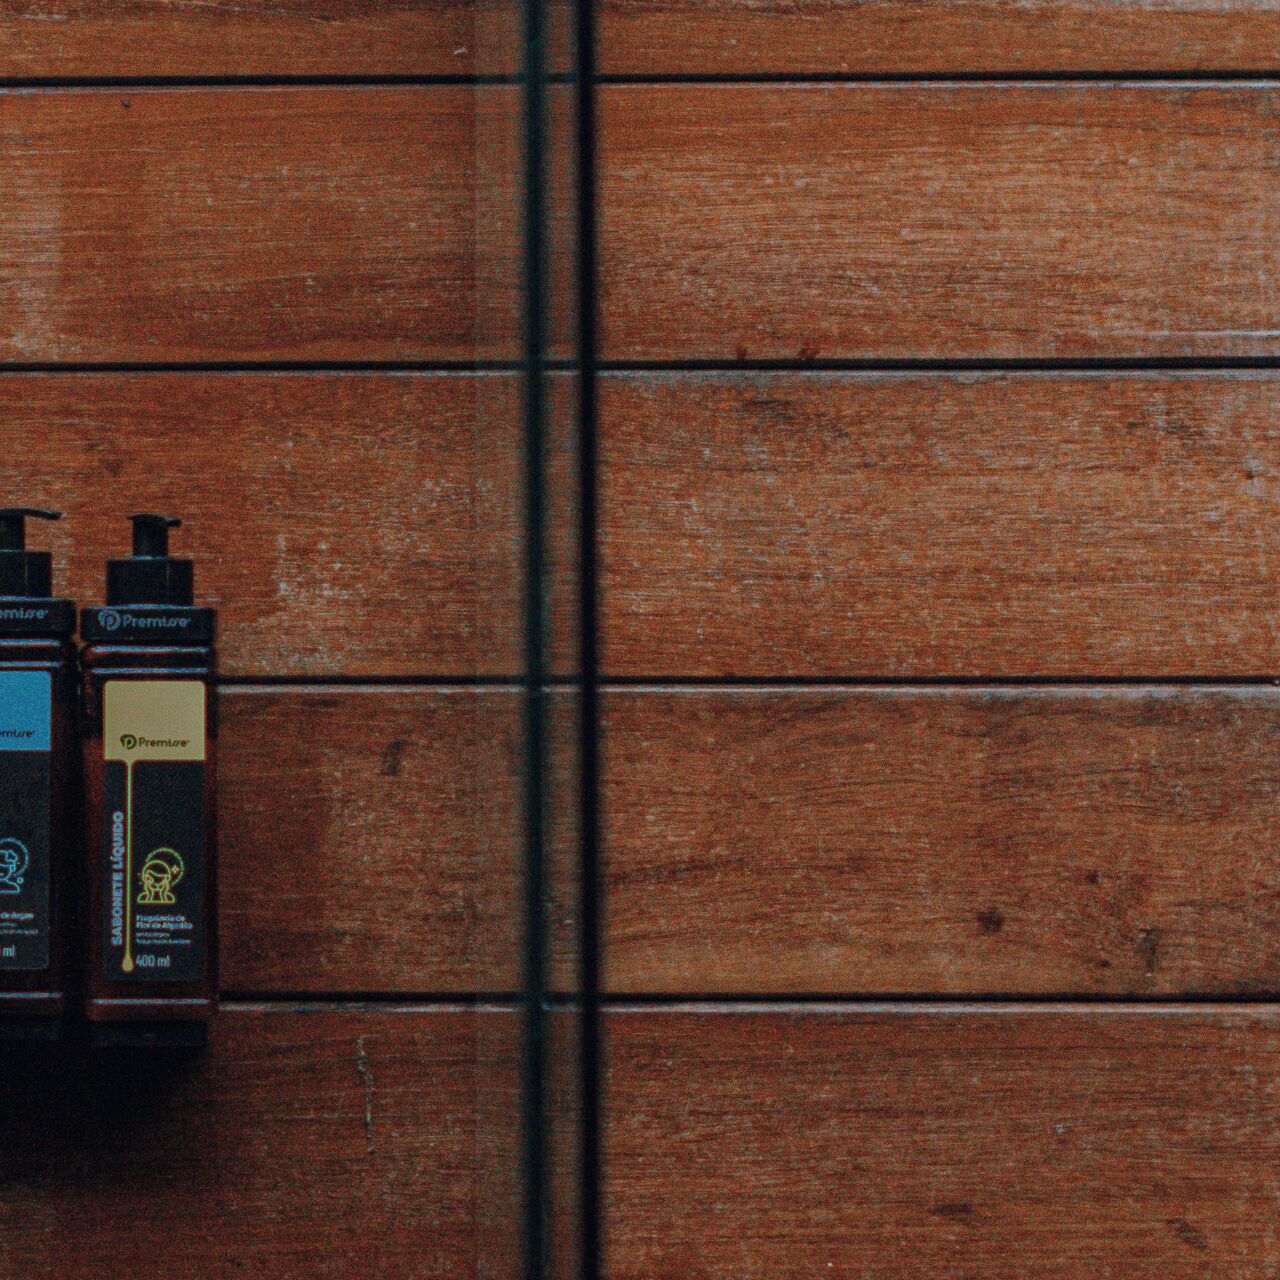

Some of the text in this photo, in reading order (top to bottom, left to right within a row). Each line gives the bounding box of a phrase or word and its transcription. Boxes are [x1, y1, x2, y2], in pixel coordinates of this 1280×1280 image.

[110, 810, 125, 946] SABONETE LÍQUIDO
[2, 944, 15, 957] ml
[136, 954, 170, 967] 400 ml
